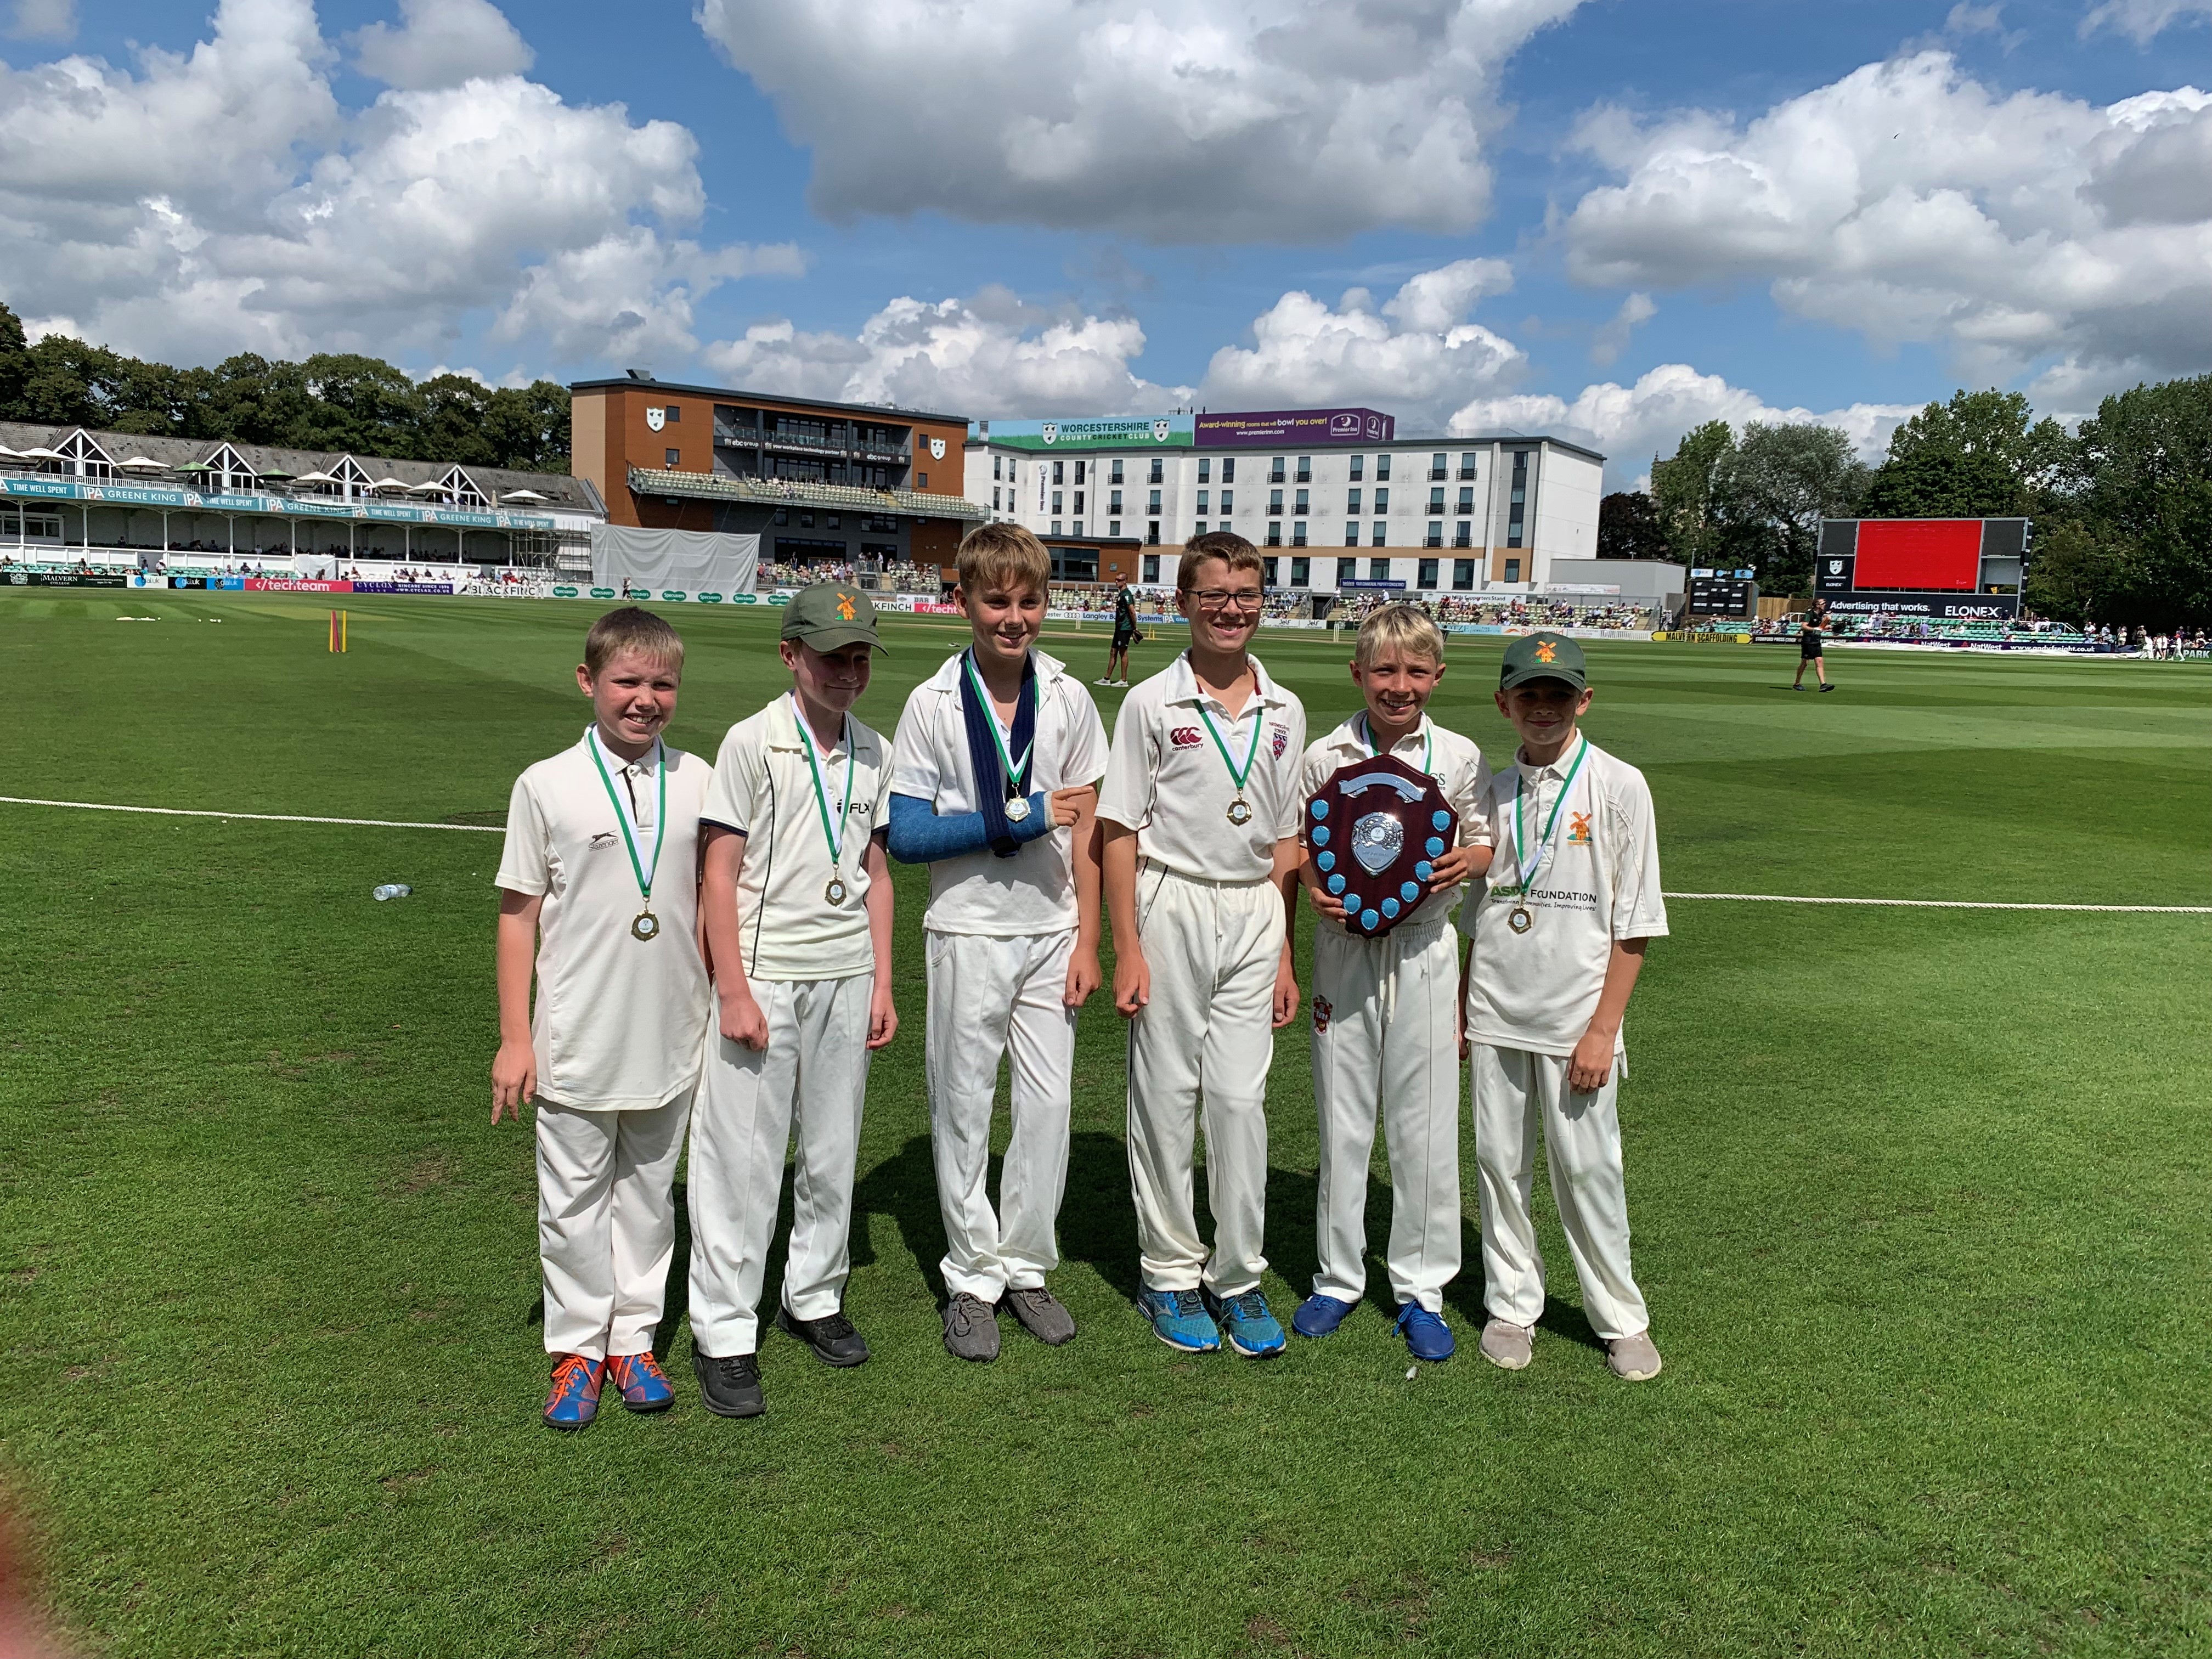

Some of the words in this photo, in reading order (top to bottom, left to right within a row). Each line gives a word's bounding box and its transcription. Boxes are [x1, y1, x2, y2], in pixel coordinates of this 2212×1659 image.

[1061, 422, 1149, 432] WORCESTERSHIRE
[1199, 420, 1245, 429] Award-winning
[1277, 418, 1294, 426] bowl
[83, 487, 104, 499] IPA
[108, 490, 147, 500] GREENE
[151, 493, 176, 501] KING
[183, 494, 203, 506] IPA
[266, 499, 284, 511] IPA
[287, 503, 321, 512] GREENE
[352, 506, 369, 517] IPA
[422, 510, 438, 521] IPA
[440, 514, 470, 522] GREENE
[472, 515, 491, 523] KING
[496, 515, 511, 527] IPA
[472, 585, 535, 595] BLACKFINC
[874, 602, 911, 611] KFINCH
[1830, 601, 1878, 612] Advertising
[1945, 606, 2002, 617] ELONEX
[1163, 615, 1175, 624] IPA
[1666, 633, 1695, 642] MALVERN
[1697, 633, 1737, 643] SCAFFOLDING
[2183, 650, 2210, 658] PARK
[1172, 743, 1204, 751] canterbury
[588, 838, 619, 850] Slazenger
[1490, 885, 1521, 897] ASD
[1531, 889, 1596, 903] FOUNDATION
[1554, 902, 1582, 911] Improving
